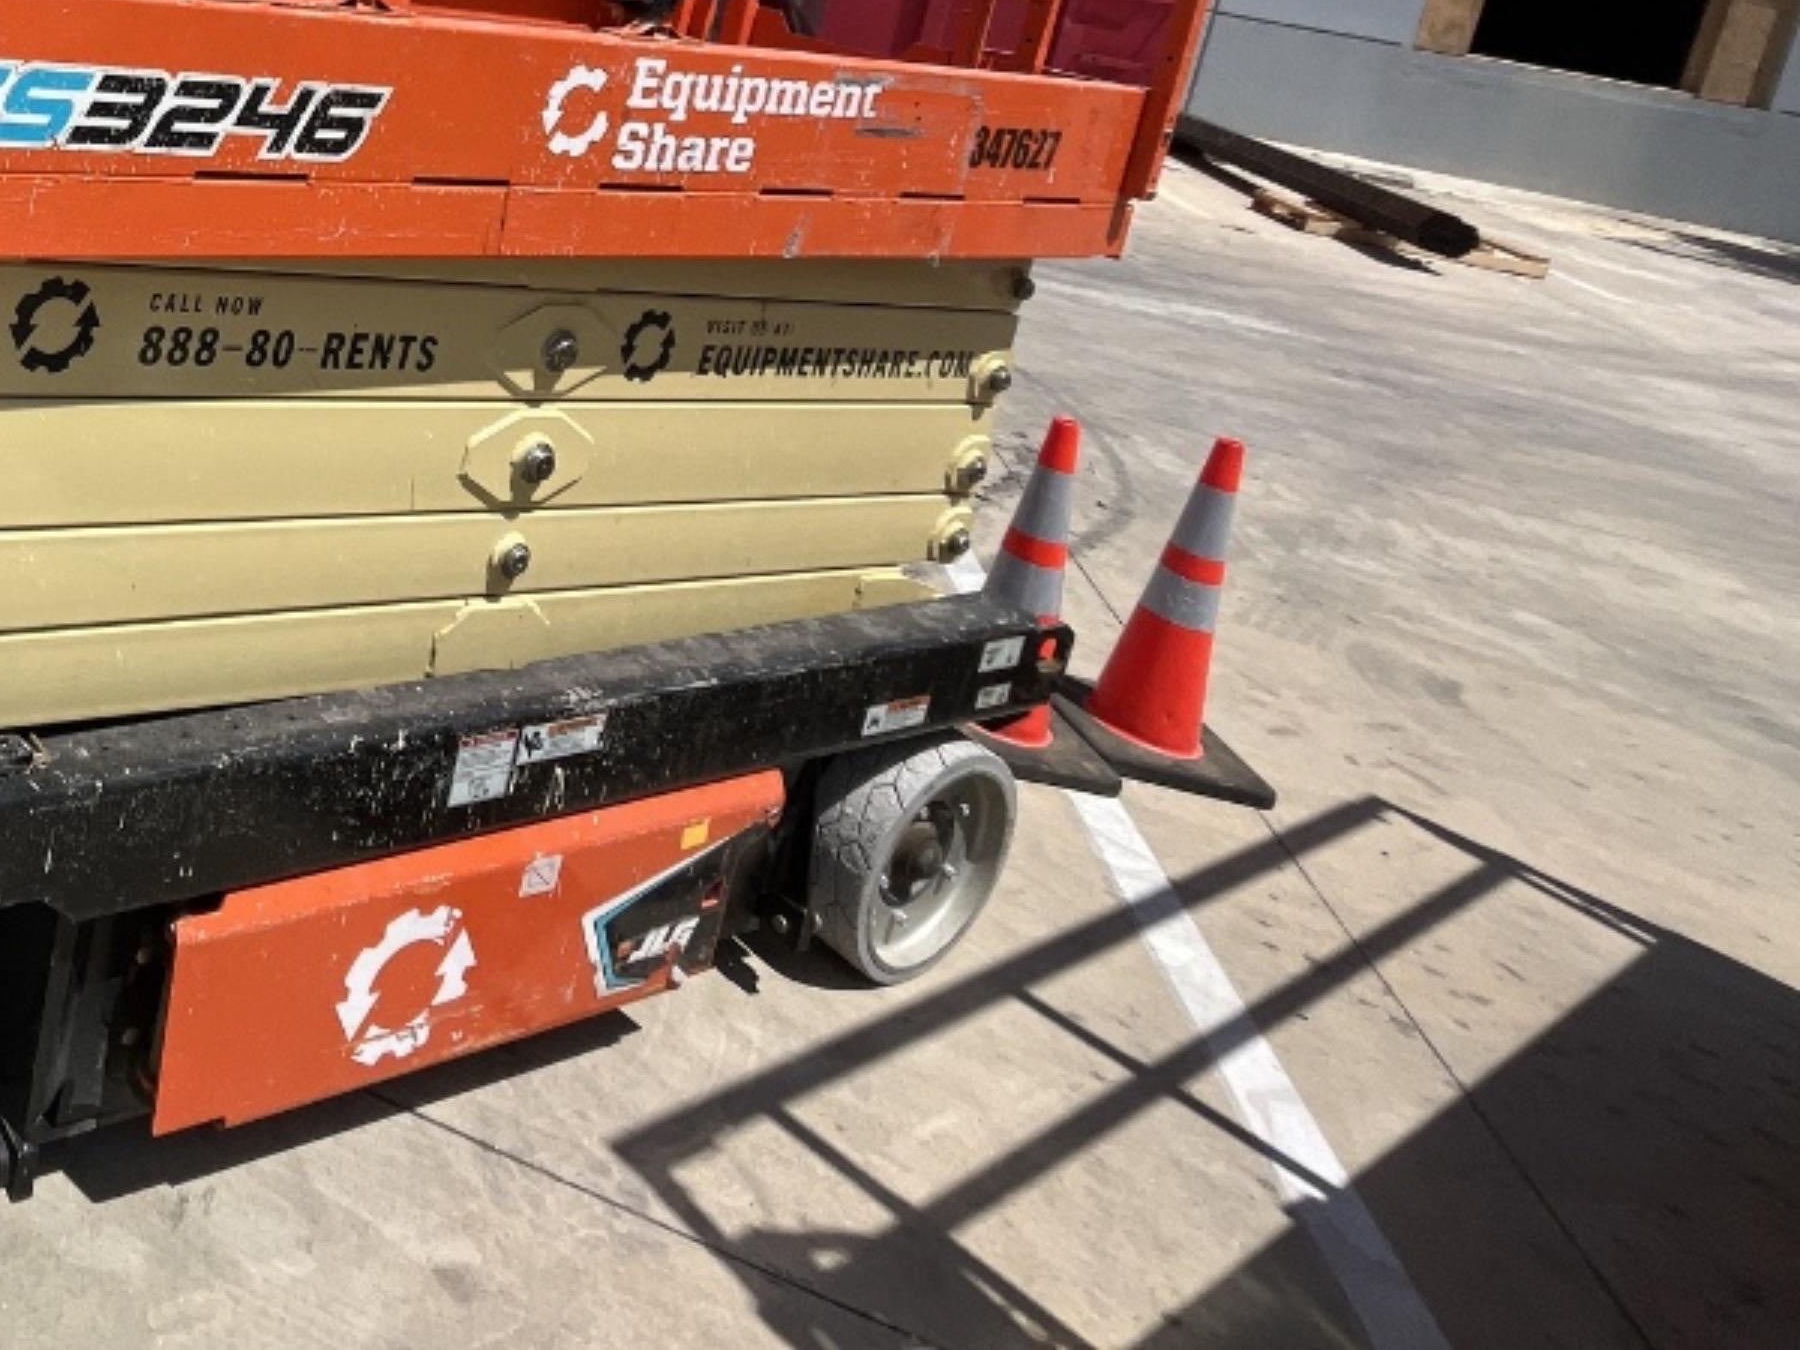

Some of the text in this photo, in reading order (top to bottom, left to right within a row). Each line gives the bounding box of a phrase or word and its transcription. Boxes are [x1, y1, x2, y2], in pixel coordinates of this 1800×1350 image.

[625, 58, 883, 122] Equipment
[612, 122, 755, 173] Share
[148, 293, 265, 318] CALL NOW
[137, 325, 440, 373] 888-80-RENTS
